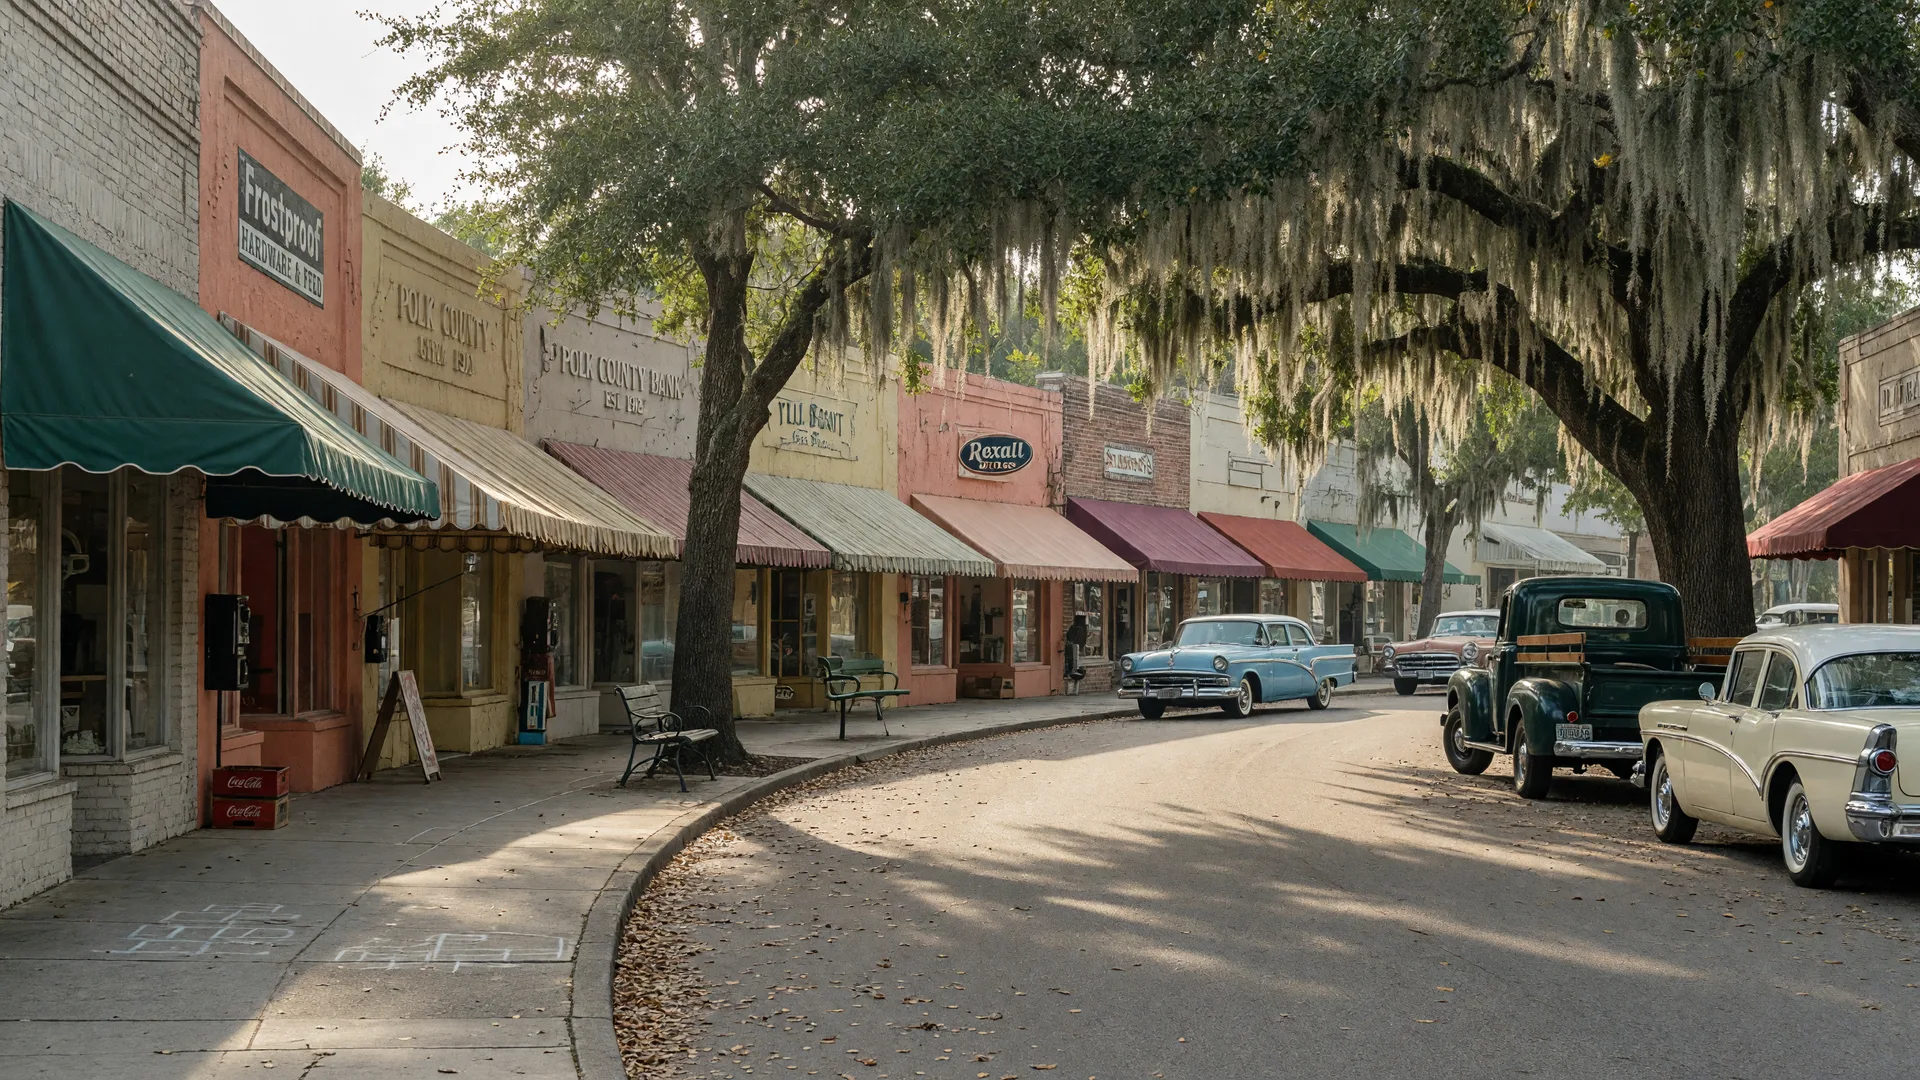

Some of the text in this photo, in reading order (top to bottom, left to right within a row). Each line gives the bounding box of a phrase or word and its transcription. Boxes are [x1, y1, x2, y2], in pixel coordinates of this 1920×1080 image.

[245, 163, 321, 261] Frostproof
[241, 225, 322, 298] HARDWARE & FEED
[397, 284, 435, 331] POLK
[440, 303, 489, 352] COUNTY
[561, 346, 684, 399] POLK COUNTY BANK
[968, 441, 1025, 463] Rexall
